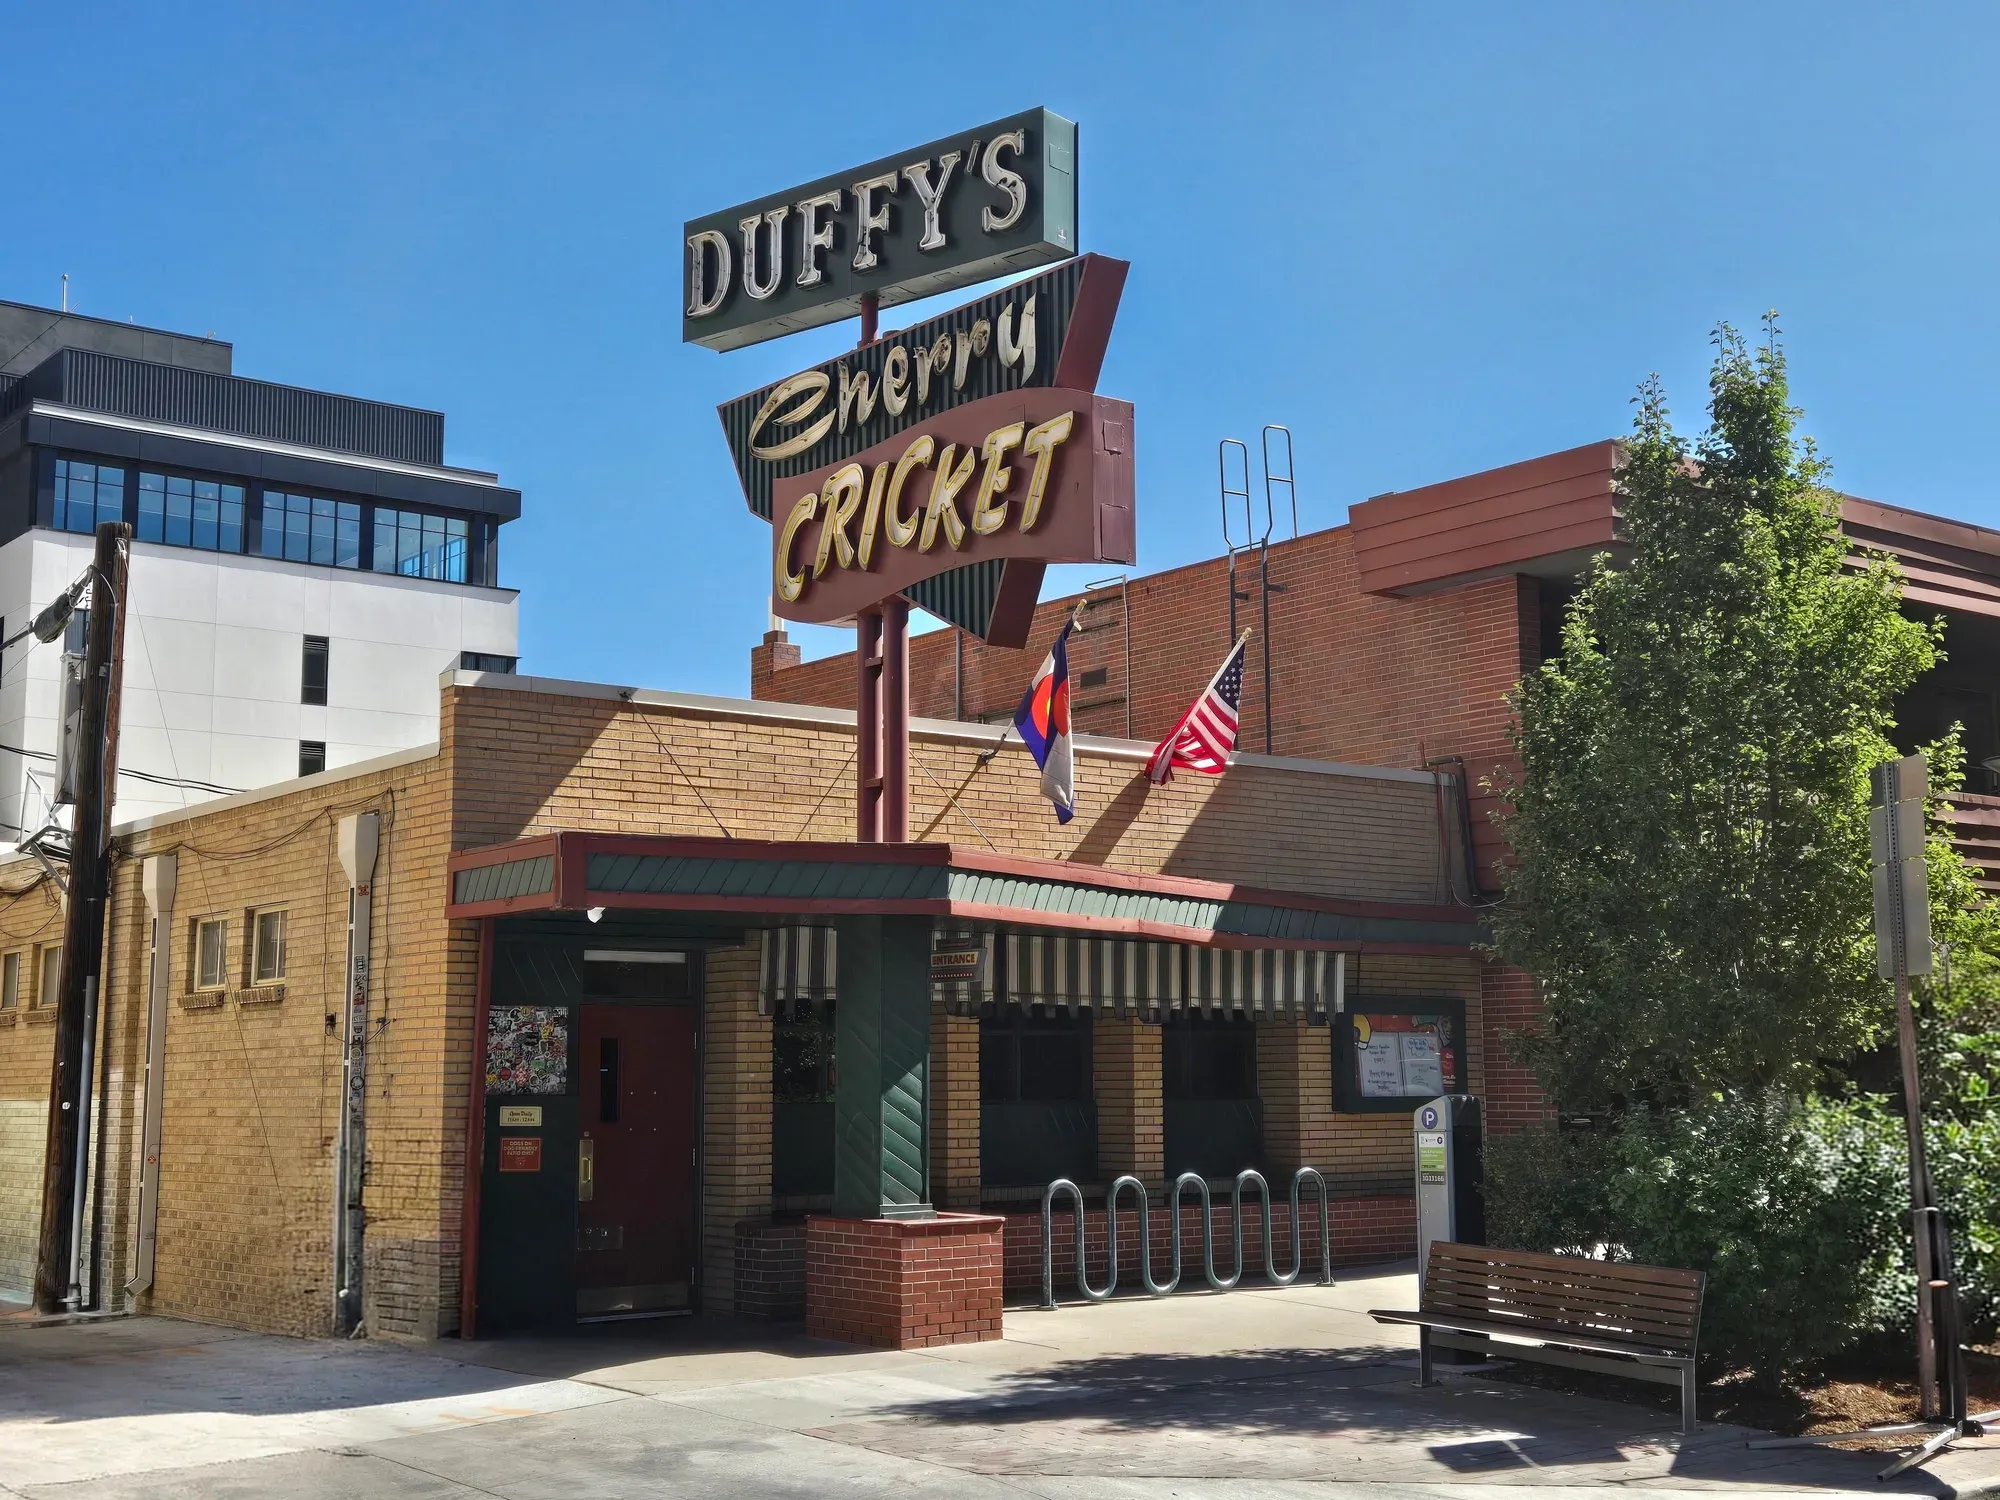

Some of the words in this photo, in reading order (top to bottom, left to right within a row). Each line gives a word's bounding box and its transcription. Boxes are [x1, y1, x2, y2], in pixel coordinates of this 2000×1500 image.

[686, 128, 1026, 318] DUFFY'S
[748, 292, 1037, 461] Cherry
[776, 411, 1075, 603] CRICKET
[932, 953, 975, 965] ENTRANCE
[1425, 1111, 1436, 1126] P
